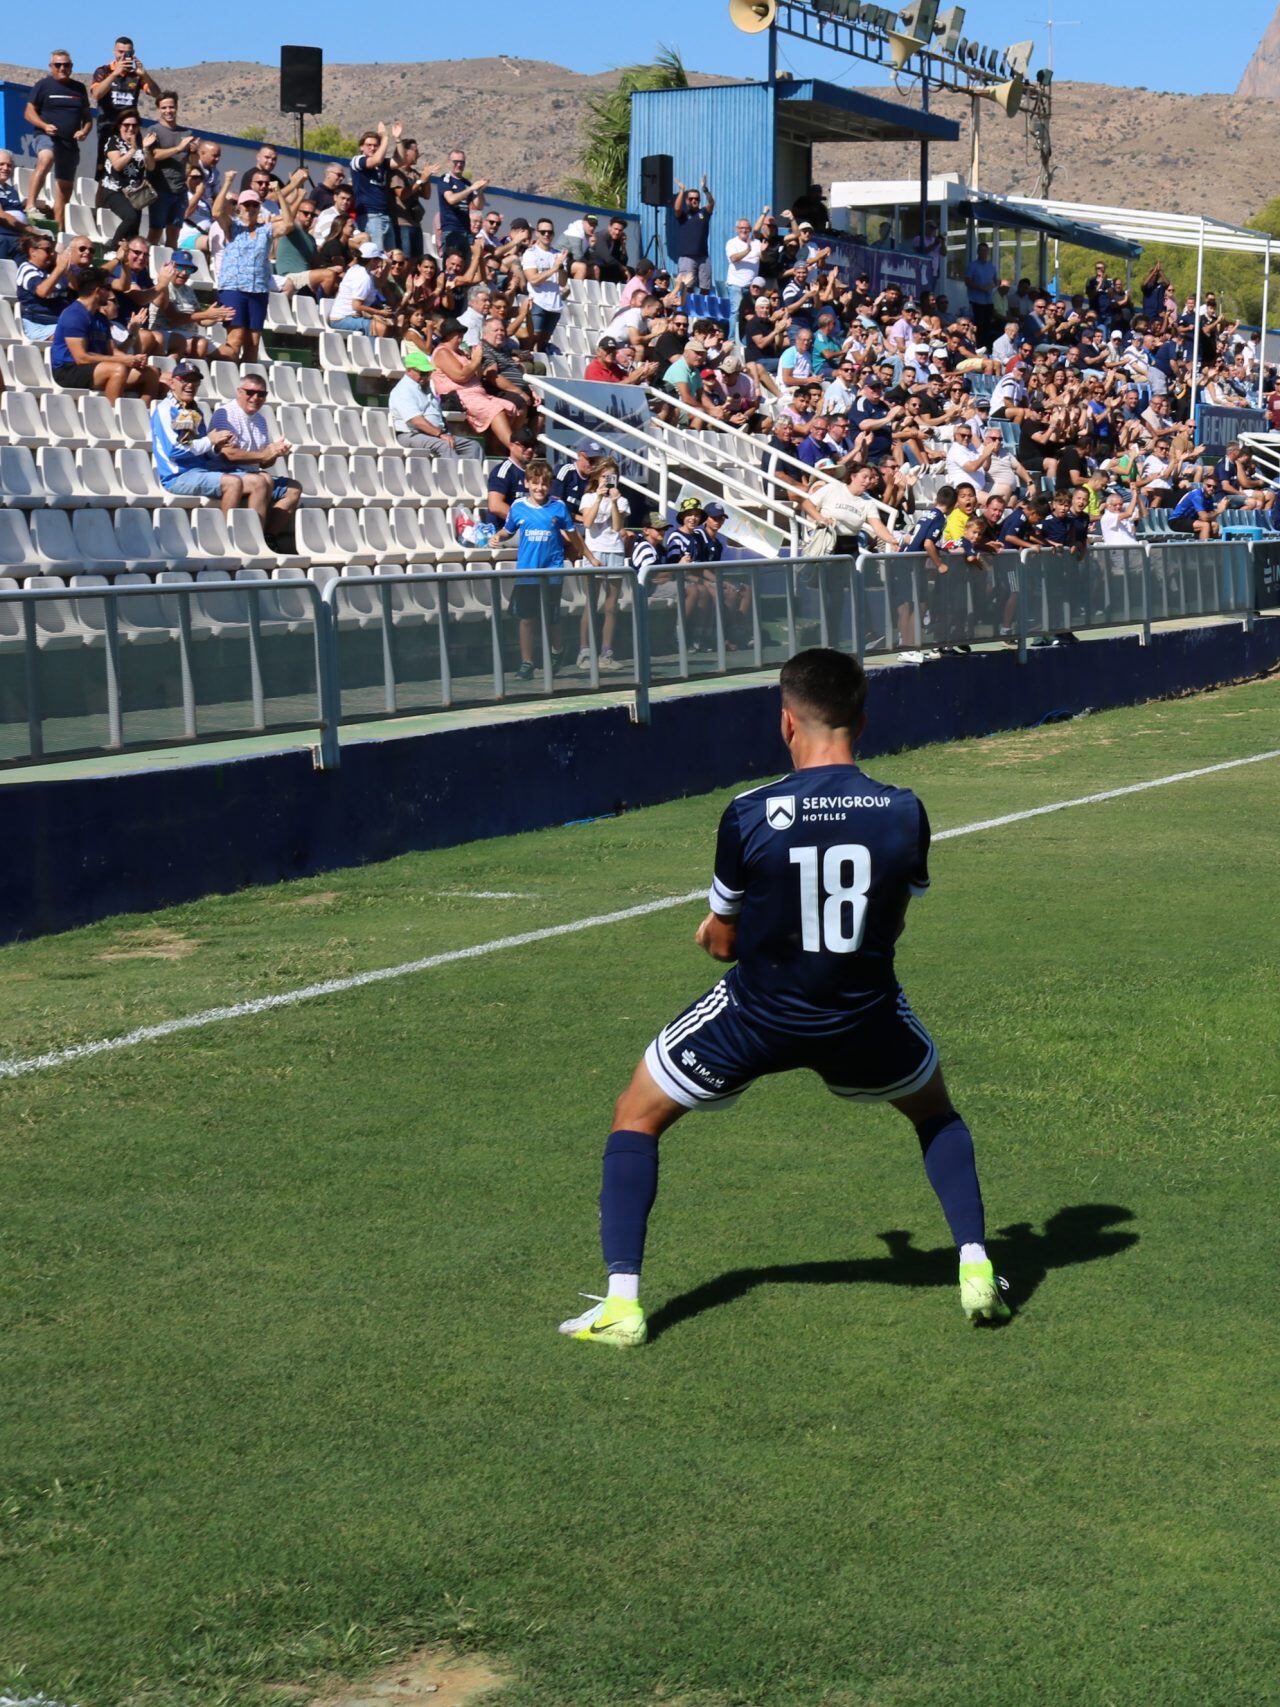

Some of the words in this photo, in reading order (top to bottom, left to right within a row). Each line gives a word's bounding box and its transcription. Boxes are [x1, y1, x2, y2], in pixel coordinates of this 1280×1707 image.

[802, 795, 891, 810] SERVIGROUP
[802, 812, 847, 822] HOTELES
[789, 844, 872, 953] 18
